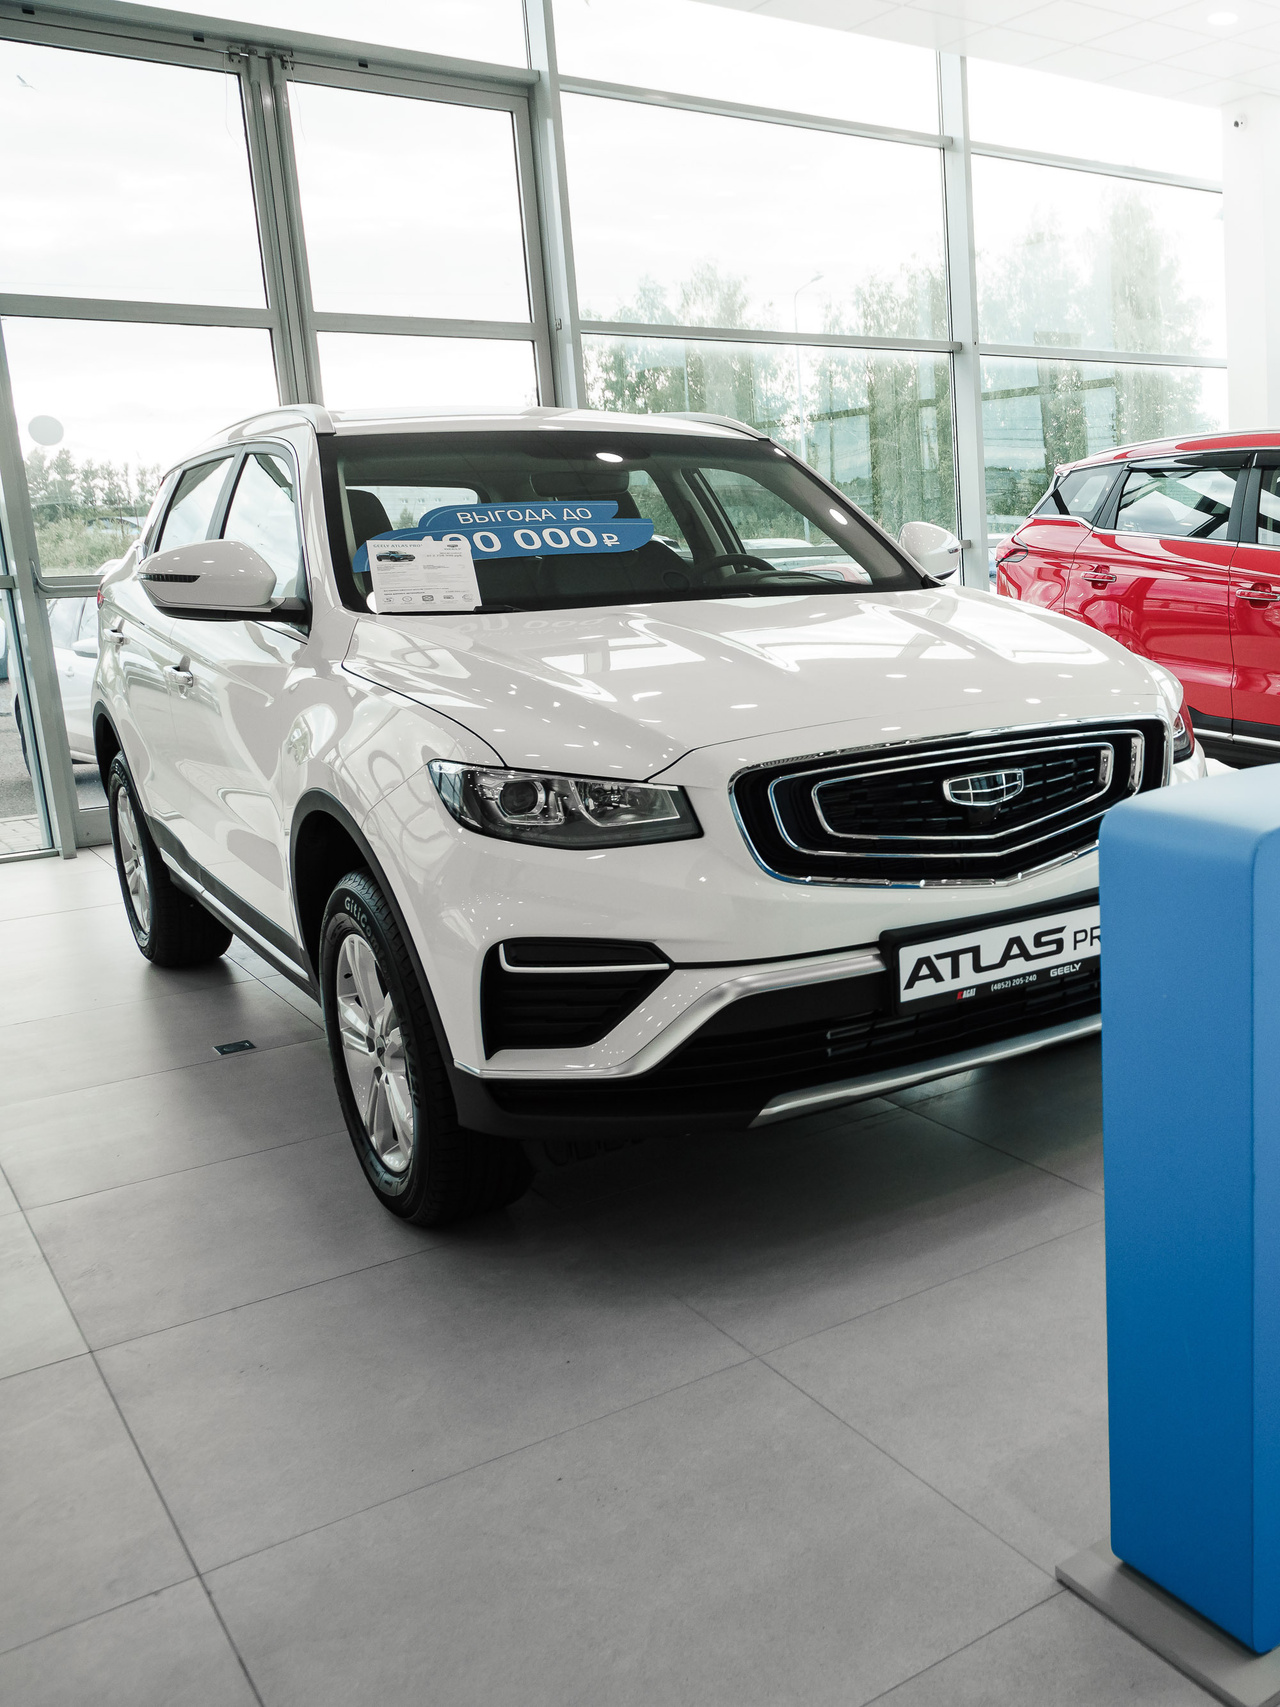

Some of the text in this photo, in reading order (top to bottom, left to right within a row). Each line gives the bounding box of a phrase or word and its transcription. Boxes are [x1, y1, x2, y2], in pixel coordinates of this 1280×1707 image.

[456, 507, 592, 524] ВЫГОДА ДО
[903, 925, 1067, 991] ATLAS
[990, 980, 1011, 992] (4852)
[1012, 974, 1037, 986] 205-240
[1050, 962, 1082, 977] GEELY
